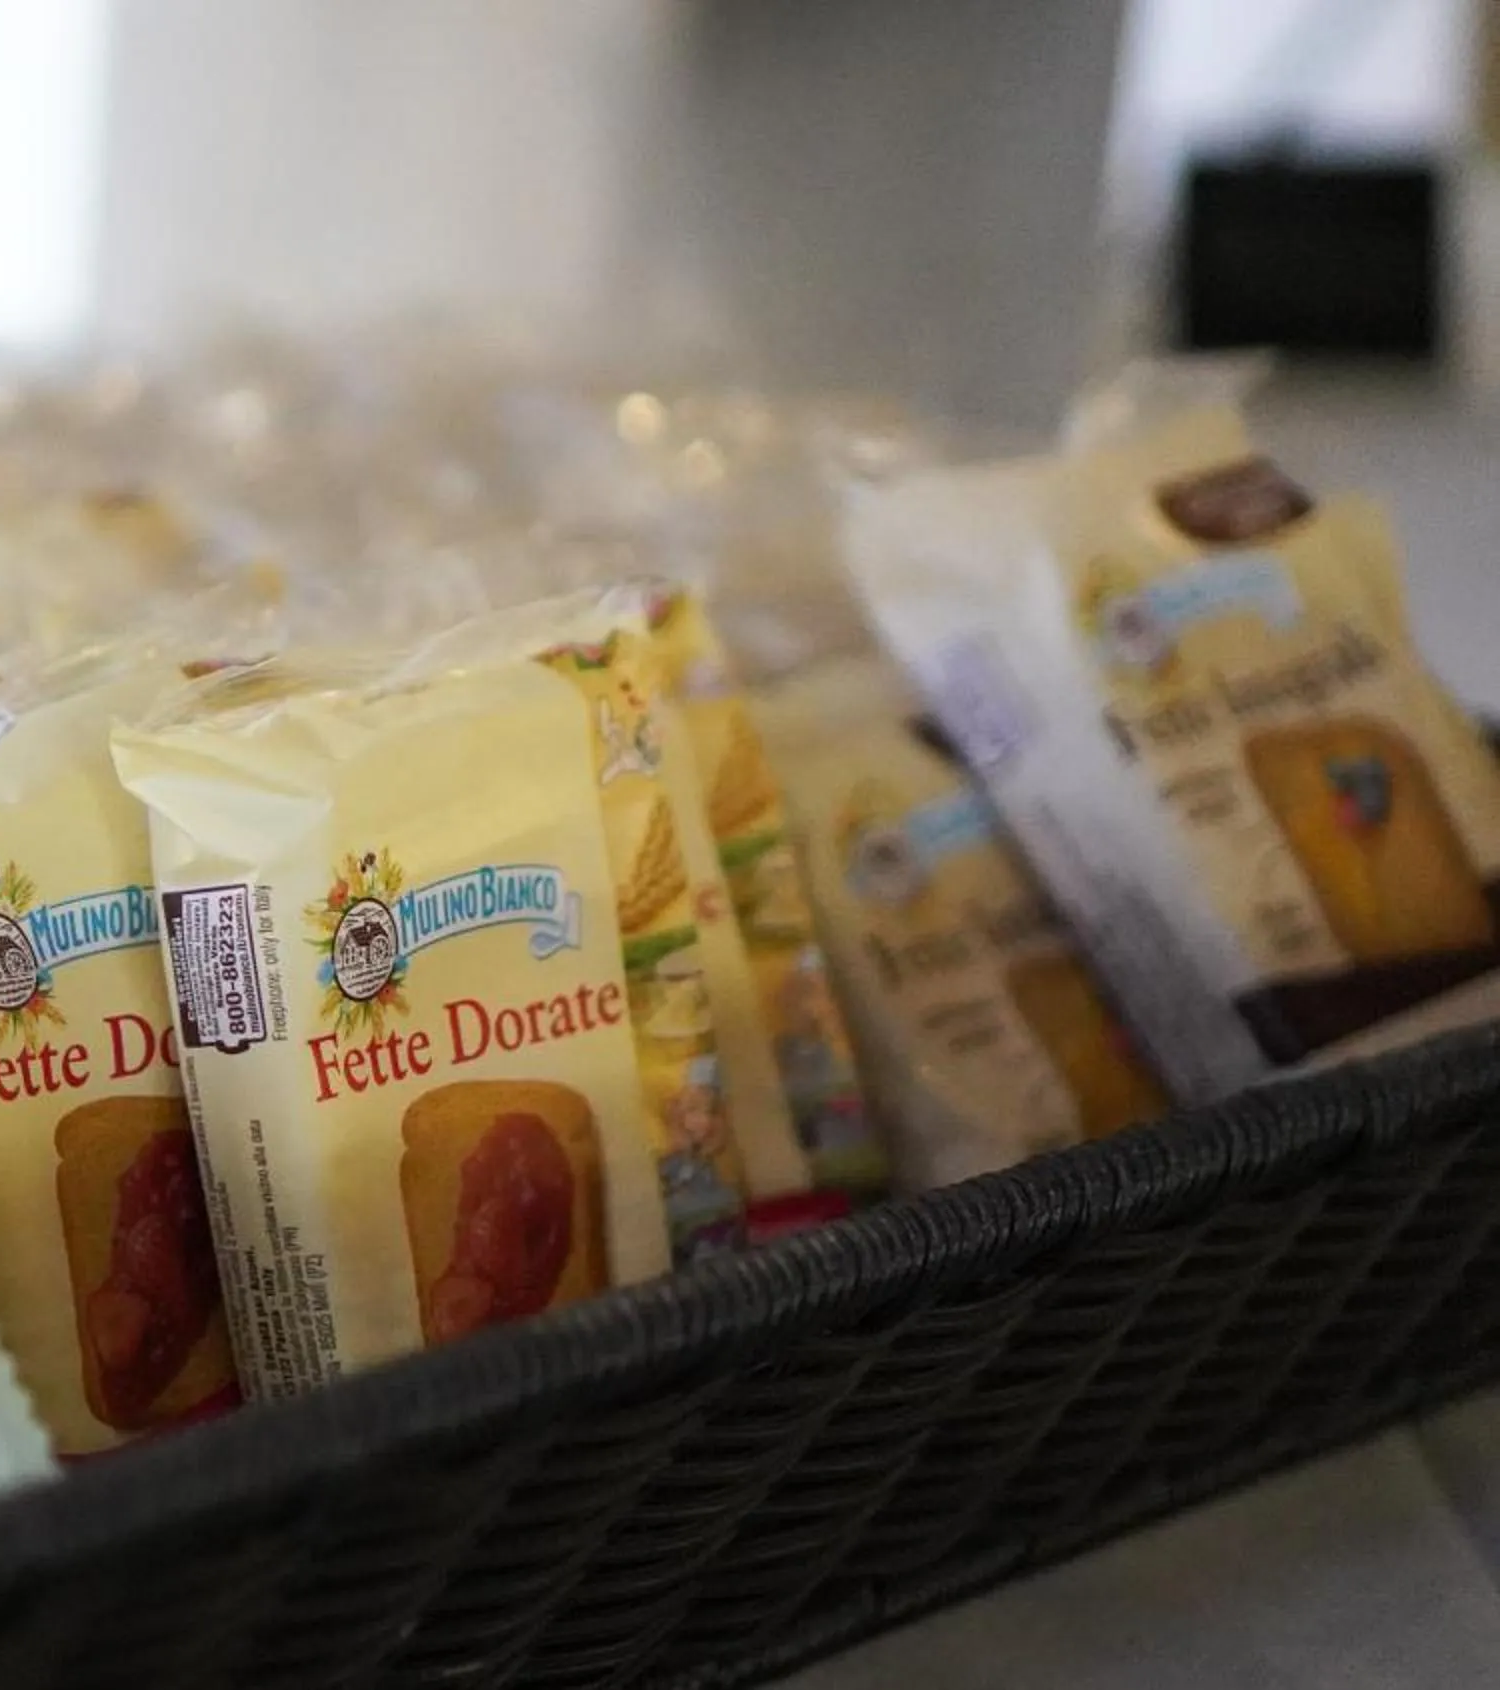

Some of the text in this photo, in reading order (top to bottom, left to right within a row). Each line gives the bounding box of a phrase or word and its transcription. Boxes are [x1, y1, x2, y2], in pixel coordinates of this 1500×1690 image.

[28, 901, 125, 963] MULINO
[400, 866, 557, 948] MULINO BIANCO
[219, 895, 246, 1035] 800-862323
[307, 981, 624, 1103] Fette Dorate
